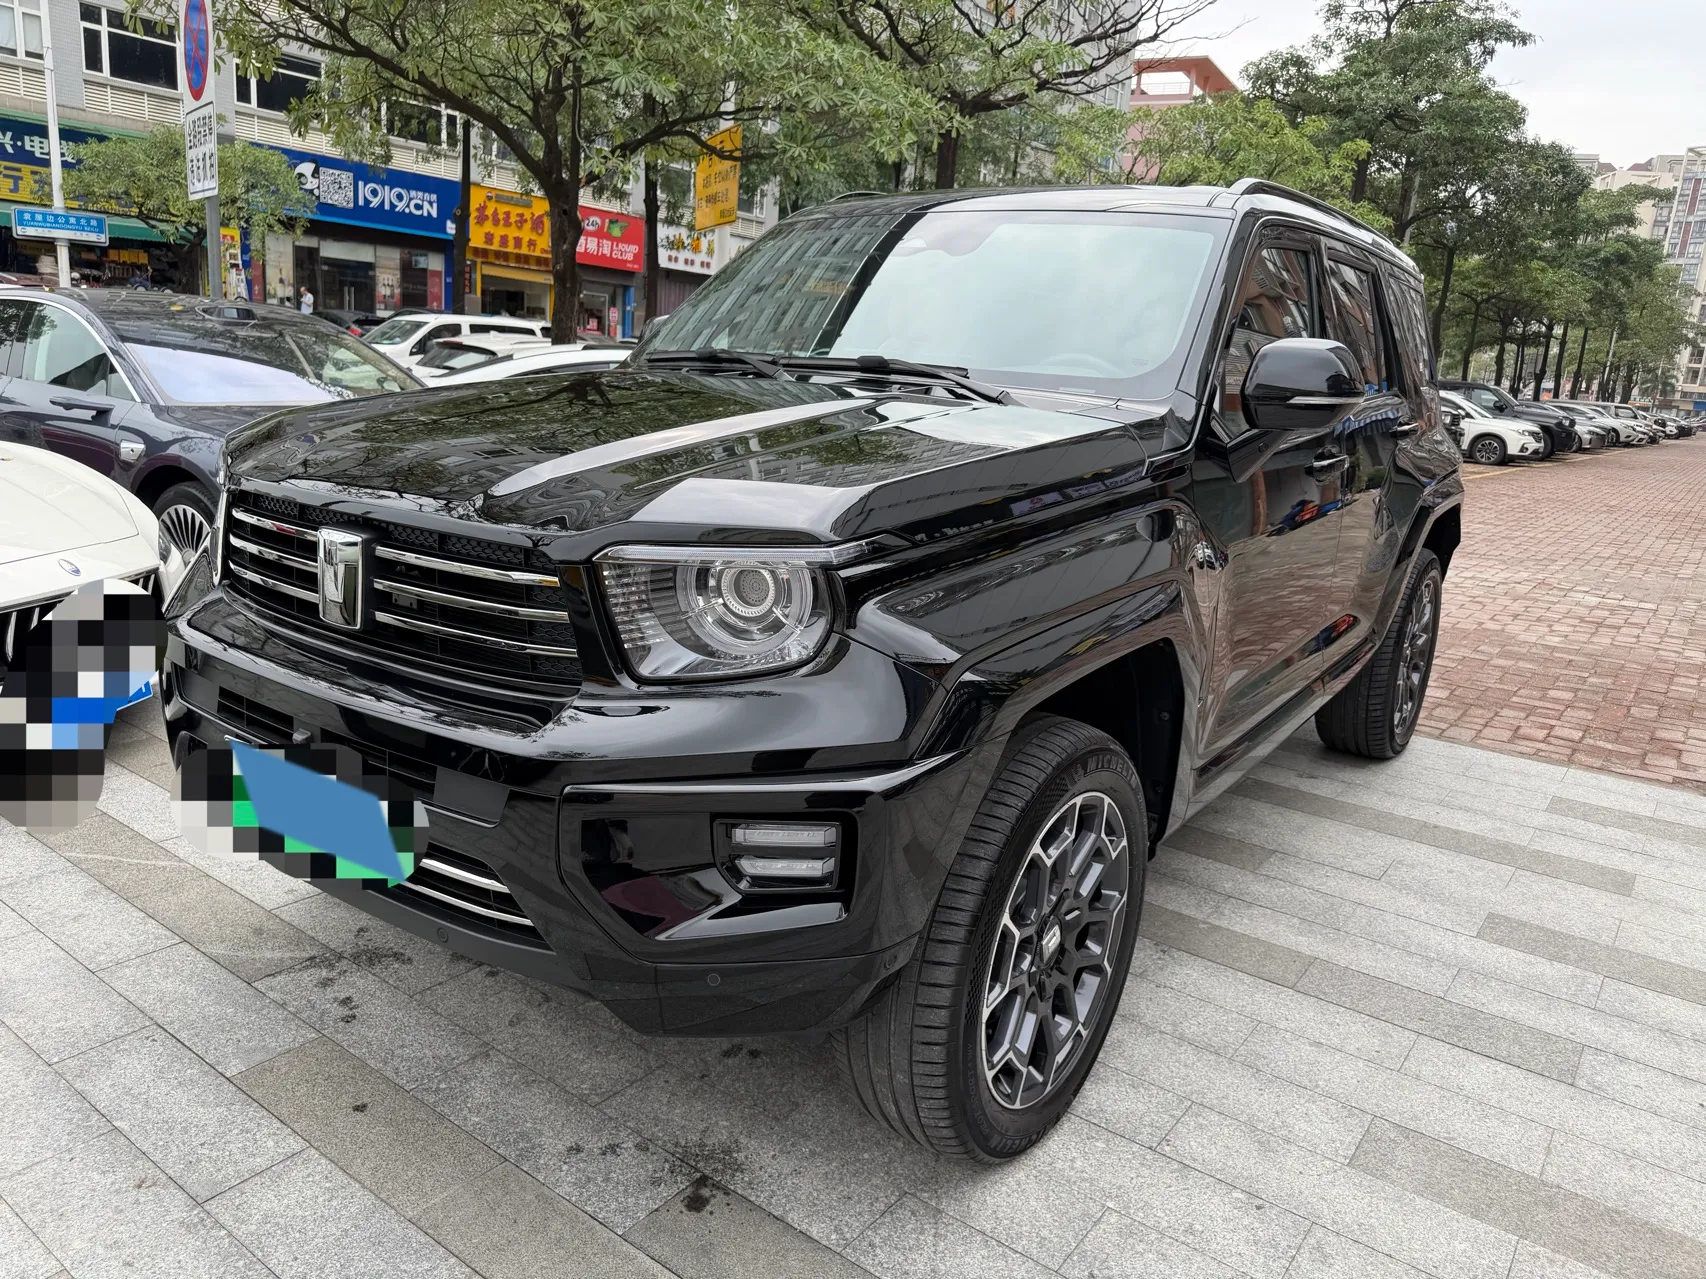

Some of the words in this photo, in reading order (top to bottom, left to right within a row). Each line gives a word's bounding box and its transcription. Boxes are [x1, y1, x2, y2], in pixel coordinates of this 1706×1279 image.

[358, 180, 438, 219] 1919.CN
[23, 212, 98, 227] 袁屋边公寓北路
[586, 217, 600, 229] 24h
[613, 241, 639, 254] LIQUID
[612, 250, 634, 261] CLUB
